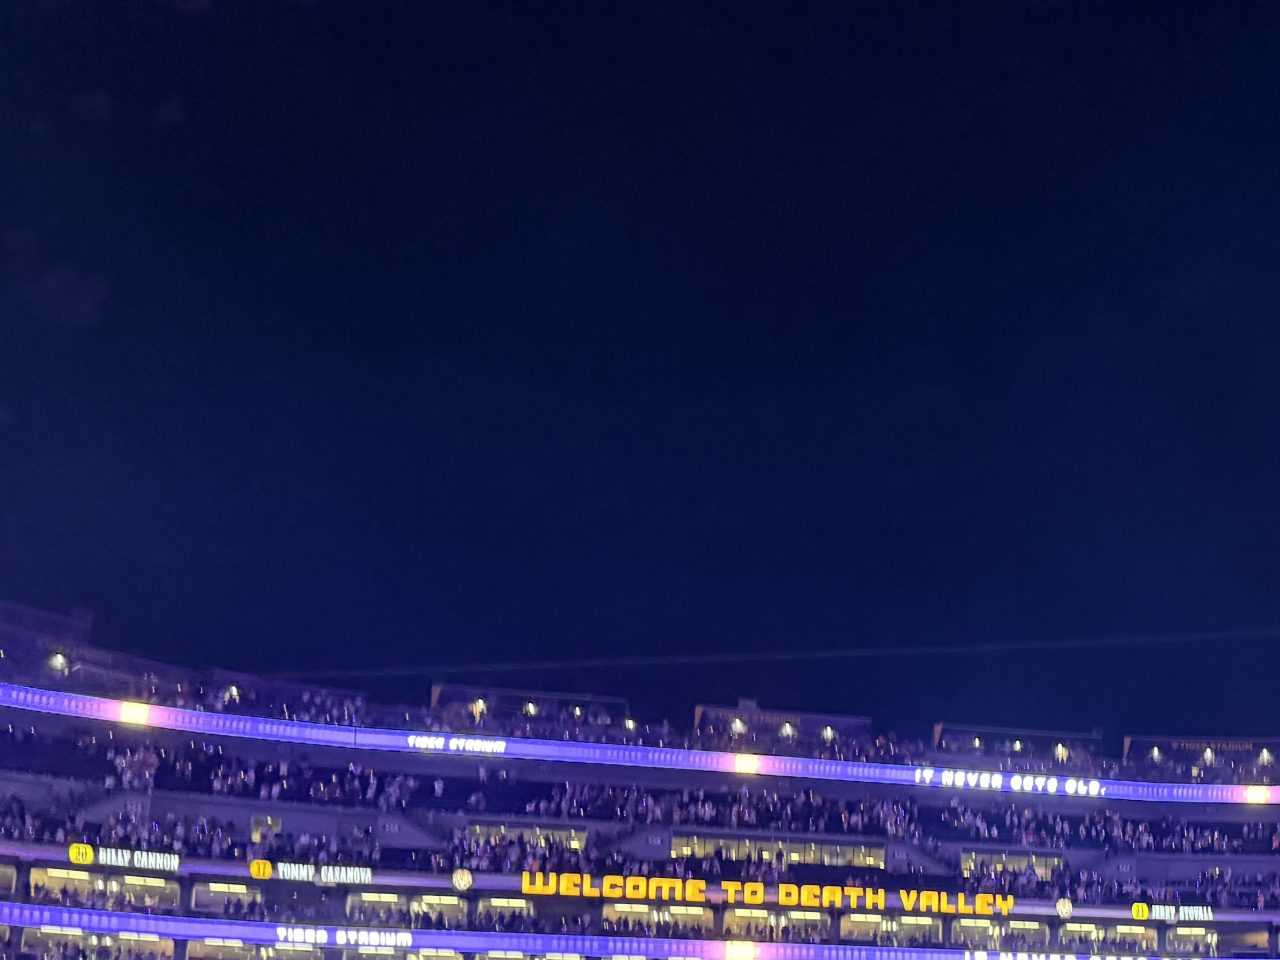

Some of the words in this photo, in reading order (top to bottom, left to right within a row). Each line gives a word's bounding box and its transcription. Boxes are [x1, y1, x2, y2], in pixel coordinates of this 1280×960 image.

[915, 769, 934, 784] IT
[941, 770, 1003, 789] NEVER
[1010, 775, 1058, 793] GETS
[98, 847, 132, 867] BILLY
[133, 850, 180, 872] CANNON
[277, 862, 315, 881] TOMMY
[320, 865, 373, 884] CASANOVA
[521, 871, 706, 903] WELCOME
[721, 880, 765, 904] TO
[778, 882, 886, 911] DEATH
[899, 889, 1014, 916] VALLEY
[275, 926, 329, 944] TIGER
[335, 929, 413, 948] STADIUM
